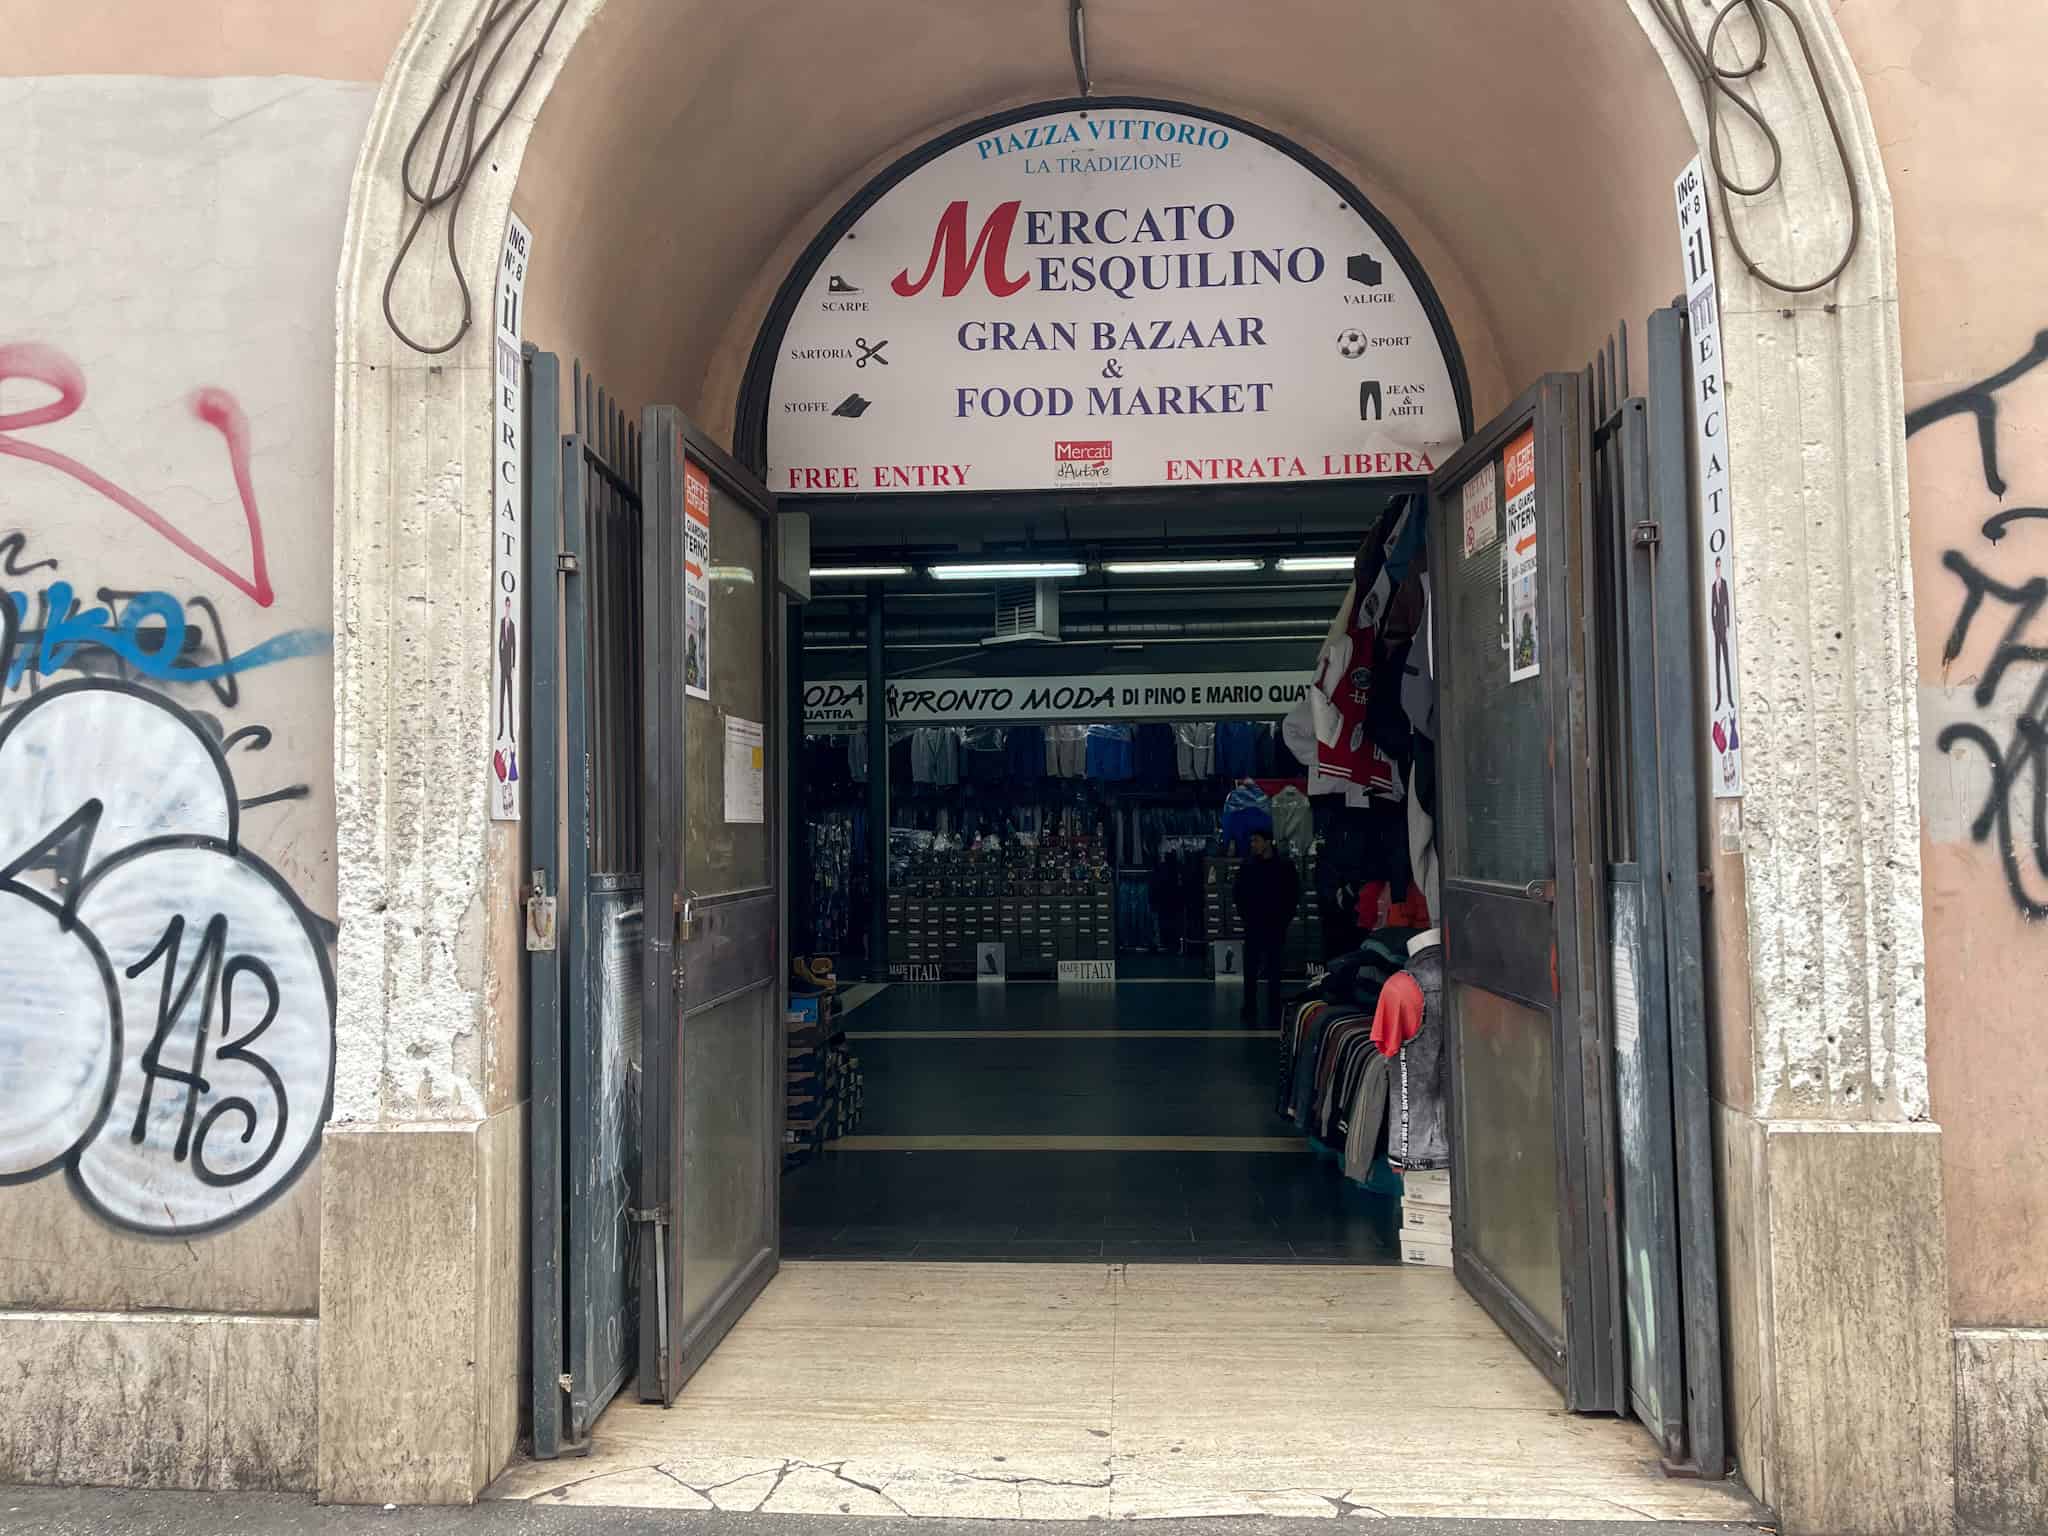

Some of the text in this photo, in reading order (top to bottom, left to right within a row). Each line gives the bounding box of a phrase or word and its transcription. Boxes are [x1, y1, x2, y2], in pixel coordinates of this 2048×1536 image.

[977, 118, 1231, 160] PIAZZA VITTORIO
[1023, 152, 1182, 175] LA TRADIZIONE
[1677, 171, 1698, 204] ING.
[1694, 194, 1701, 213] 8
[509, 224, 526, 257] ING.
[890, 200, 1235, 298] MERCATO
[516, 264, 522, 281] 8
[1039, 246, 1326, 299] ESQUILINO
[821, 303, 870, 312] SCARPE
[1343, 292, 1397, 305] VALIGIE
[957, 316, 1267, 352] GRAN BAZAAR
[1370, 336, 1411, 348] SPORT
[791, 347, 853, 361] SARTORIA
[1101, 359, 1124, 379] &
[954, 383, 1273, 418] FOOD MARKET
[1386, 384, 1425, 396] JEANS
[784, 402, 828, 415] STOFFE
[1388, 405, 1424, 416] ABITI
[1058, 443, 1111, 460] Mercati
[788, 464, 972, 490] FREE ENTRY
[1166, 452, 1434, 481] ENTRATA LIBERA
[1508, 506, 1537, 537] INTERN
[900, 690, 1012, 714] PRONTO
[1020, 685, 1115, 710] MODA
[1122, 688, 1139, 705] DI
[1145, 687, 1186, 704] PINO
[1191, 687, 1201, 704] E
[1206, 685, 1263, 703] MARIO
